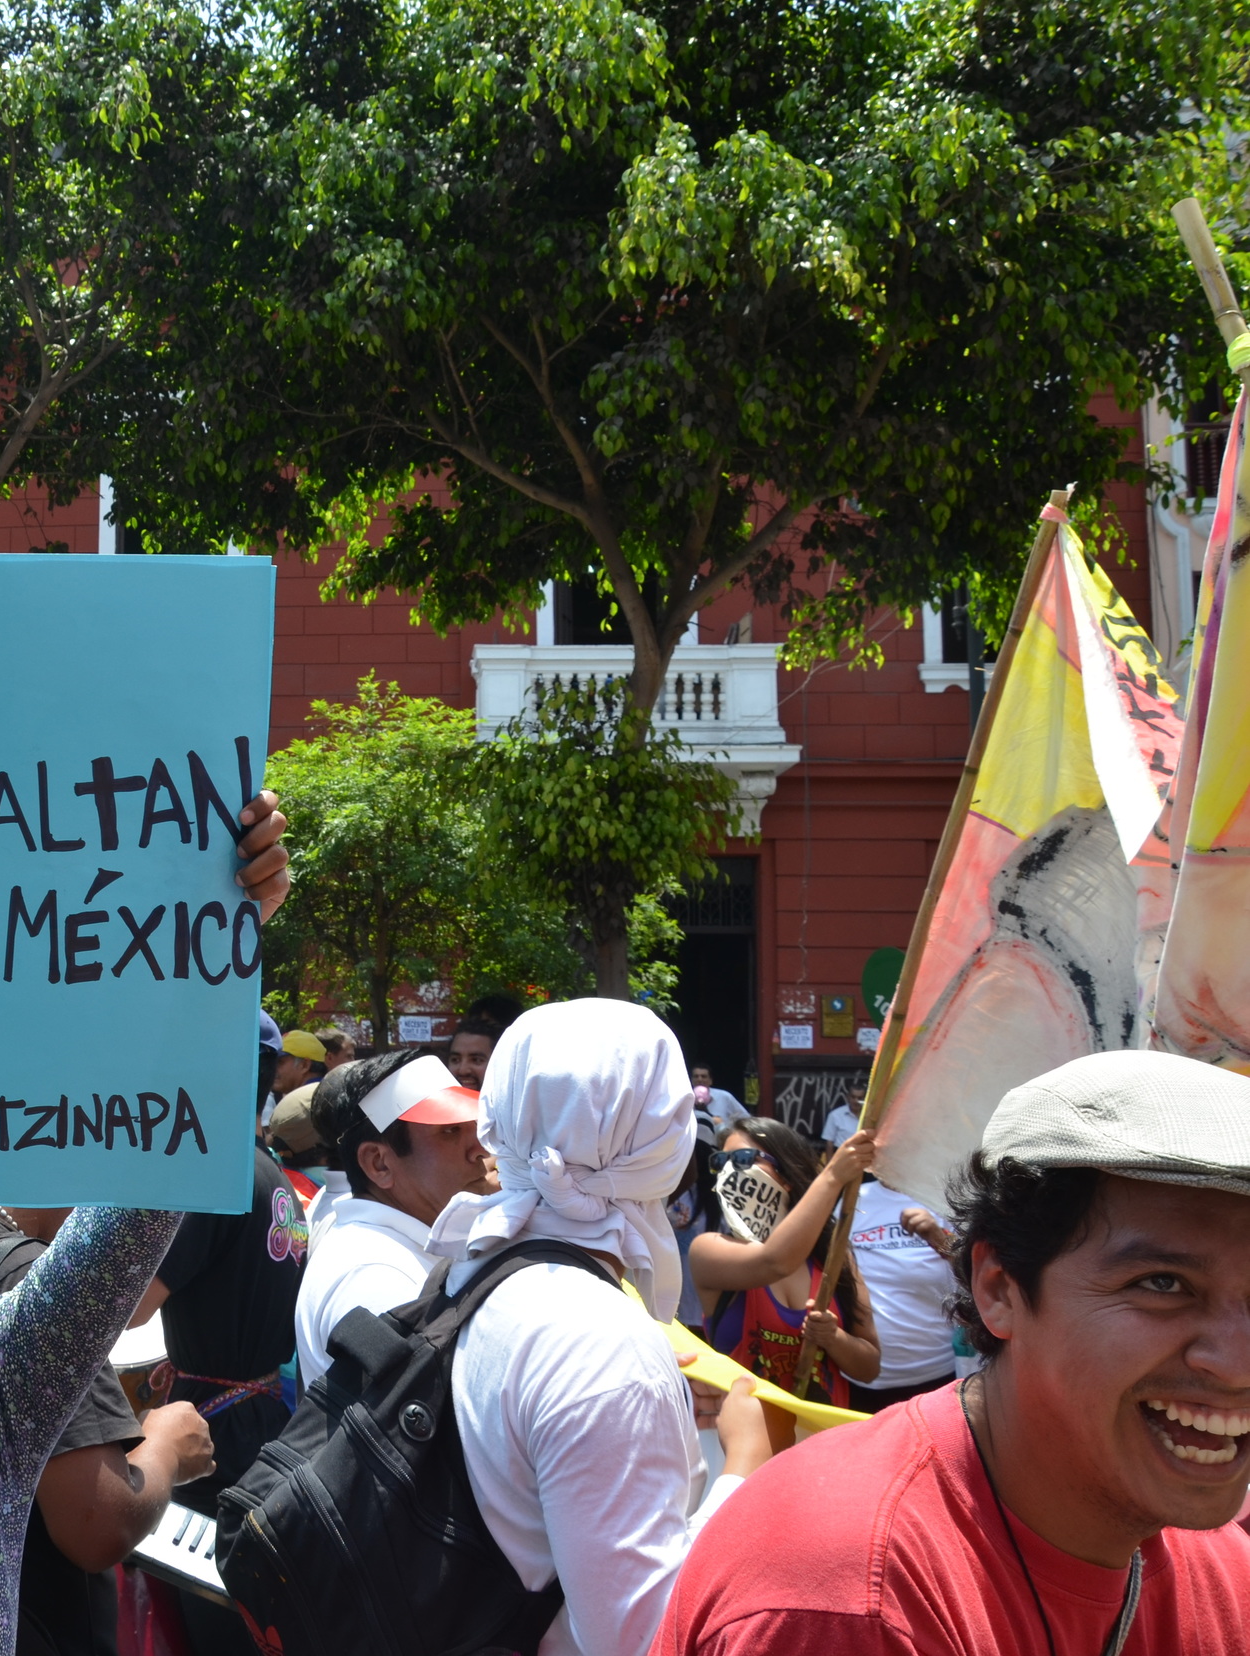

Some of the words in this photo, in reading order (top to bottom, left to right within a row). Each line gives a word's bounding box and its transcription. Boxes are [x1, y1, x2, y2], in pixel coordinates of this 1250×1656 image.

[4, 868, 262, 985] MÉXICO
[723, 1171, 782, 1213] AGUA
[753, 1204, 777, 1227] UN
